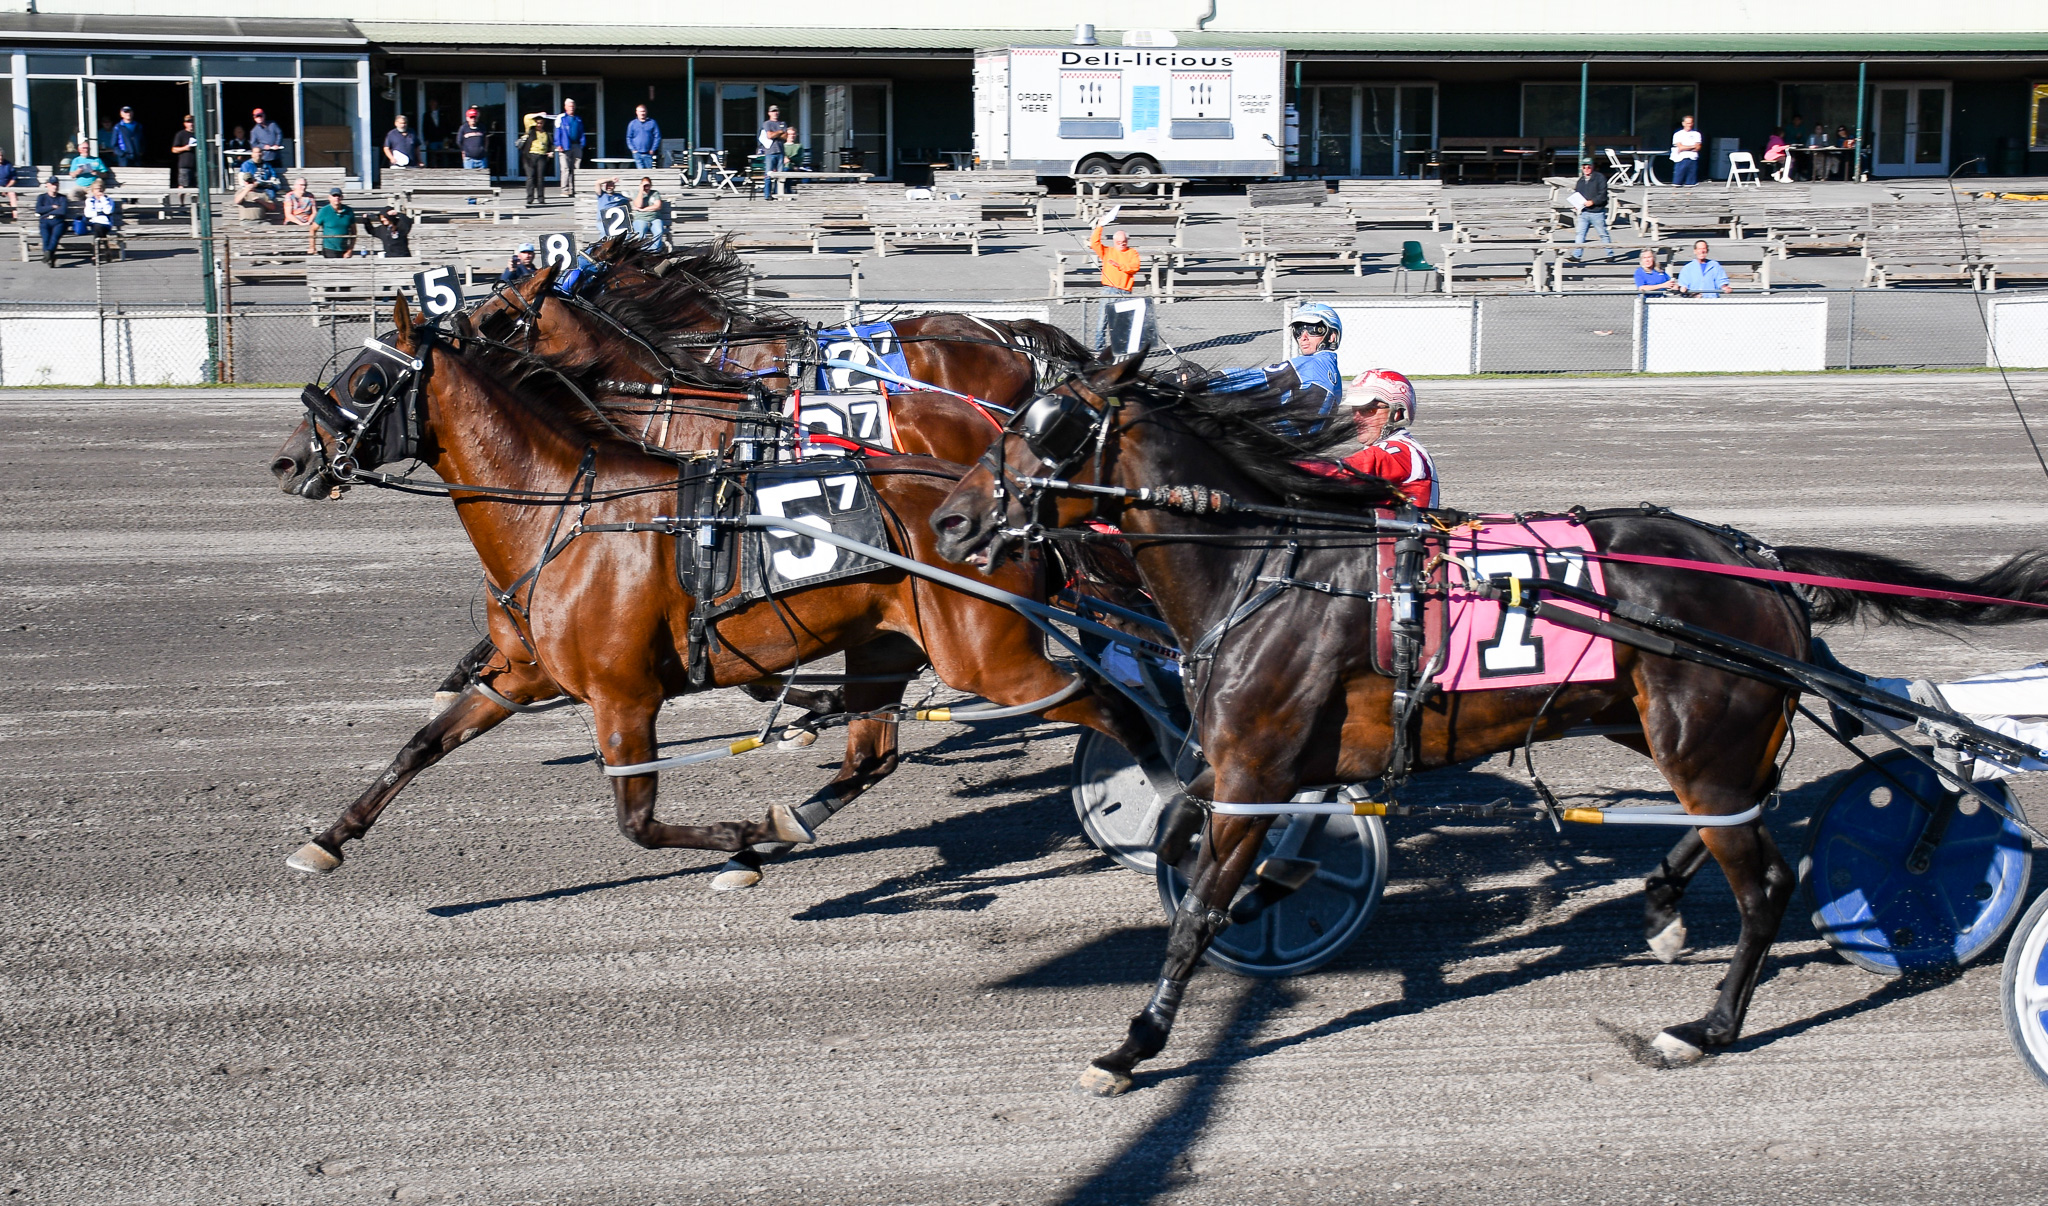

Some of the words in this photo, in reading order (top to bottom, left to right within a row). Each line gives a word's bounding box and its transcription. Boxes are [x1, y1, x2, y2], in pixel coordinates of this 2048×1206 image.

[1061, 51, 1233, 67] Deli-licious
[1017, 92, 1053, 102] ORDER
[1020, 104, 1048, 113] HERE
[605, 206, 629, 237] 2
[546, 233, 573, 271] 8
[423, 266, 457, 315] 5
[870, 330, 893, 355] 7
[1114, 298, 1147, 354] 7
[850, 402, 878, 439] 7
[756, 479, 839, 580] 5
[824, 474, 858, 511] 7
